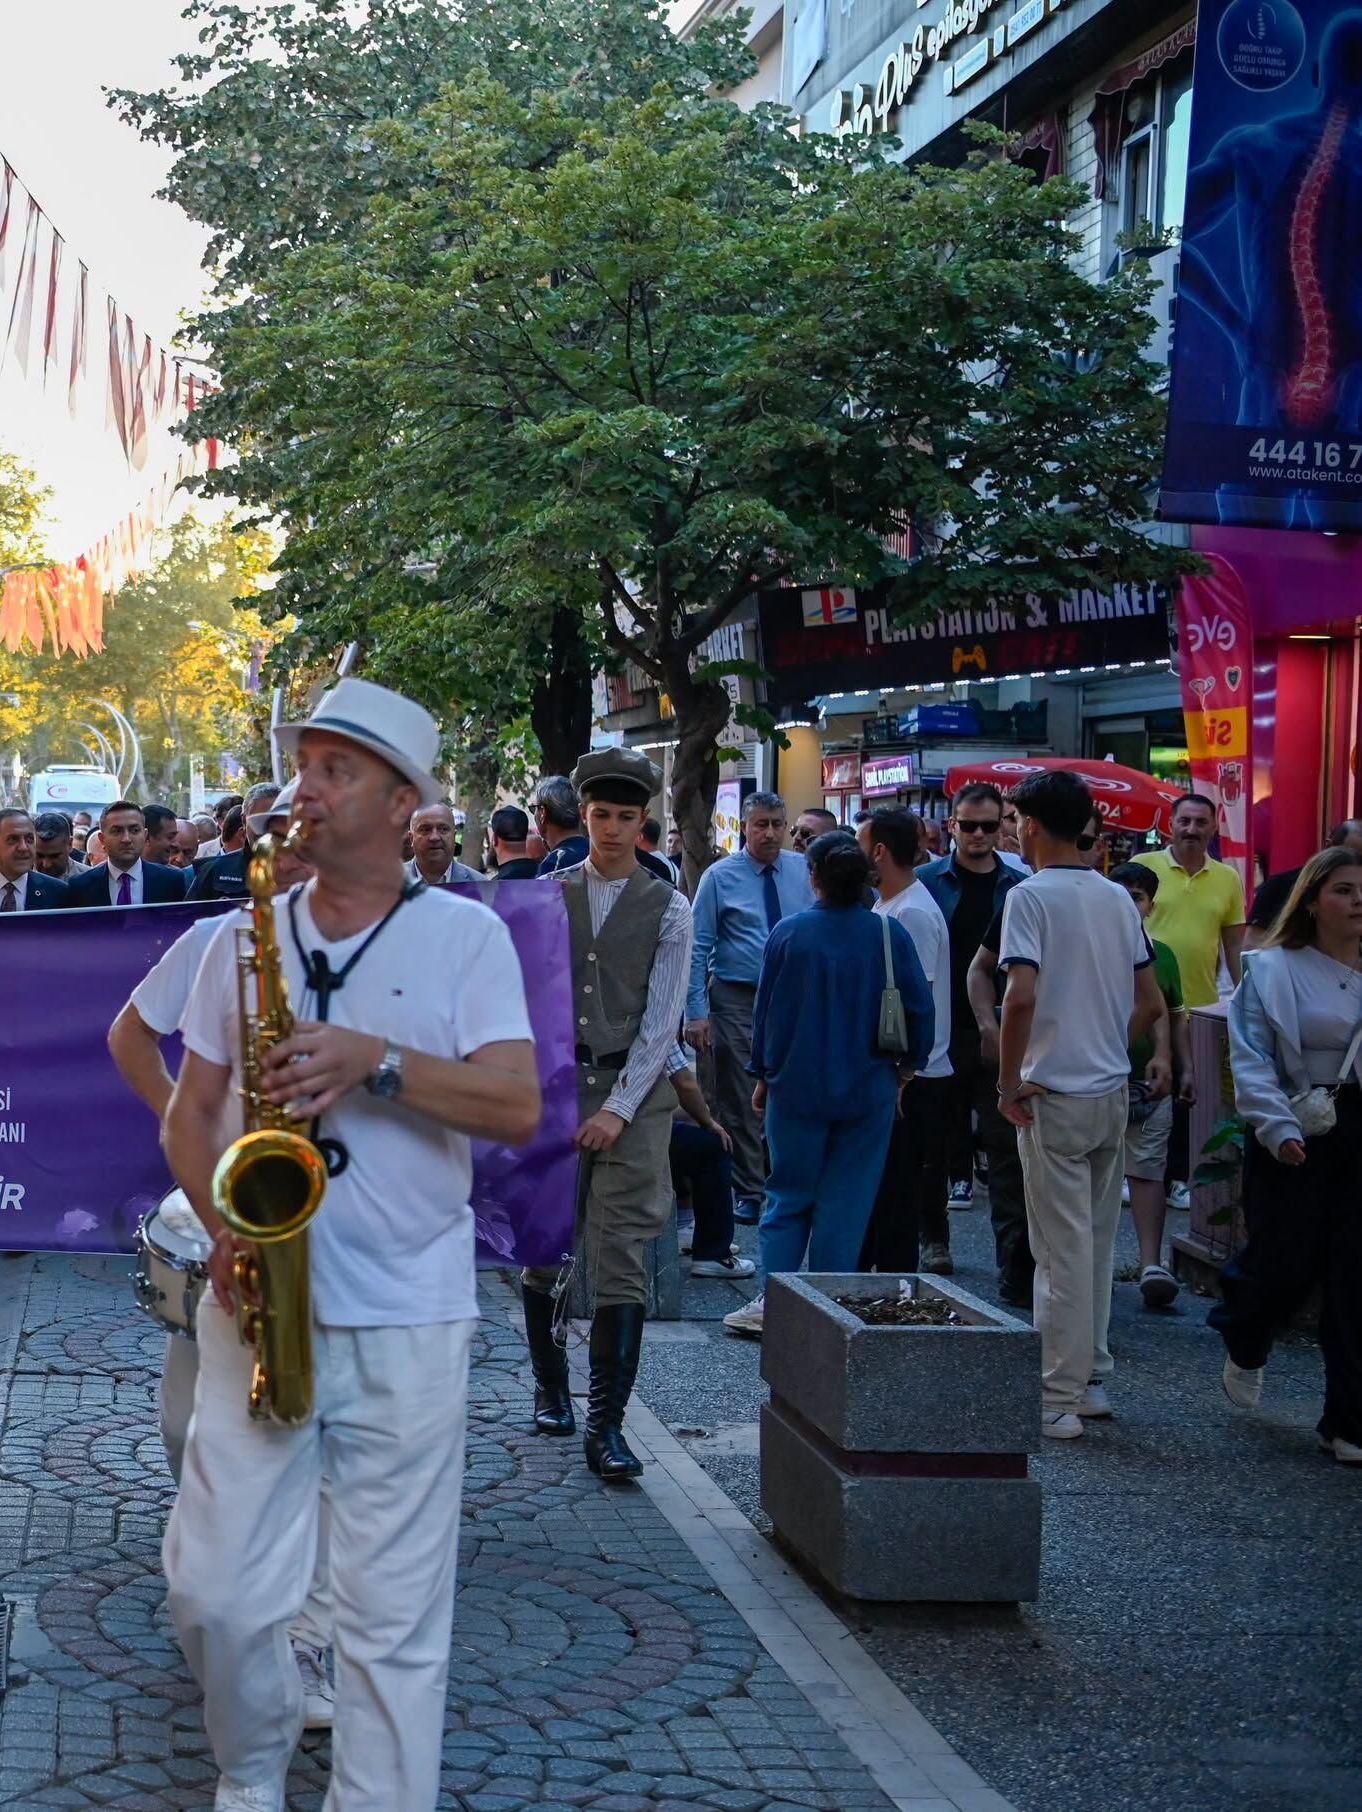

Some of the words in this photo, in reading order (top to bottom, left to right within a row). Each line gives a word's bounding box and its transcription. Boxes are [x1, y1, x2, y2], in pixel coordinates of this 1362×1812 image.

[1249, 438, 1306, 465] 444
[1313, 441, 1341, 467] 16
[1025, 591, 1049, 628] &
[1058, 580, 1158, 624] MARKET
